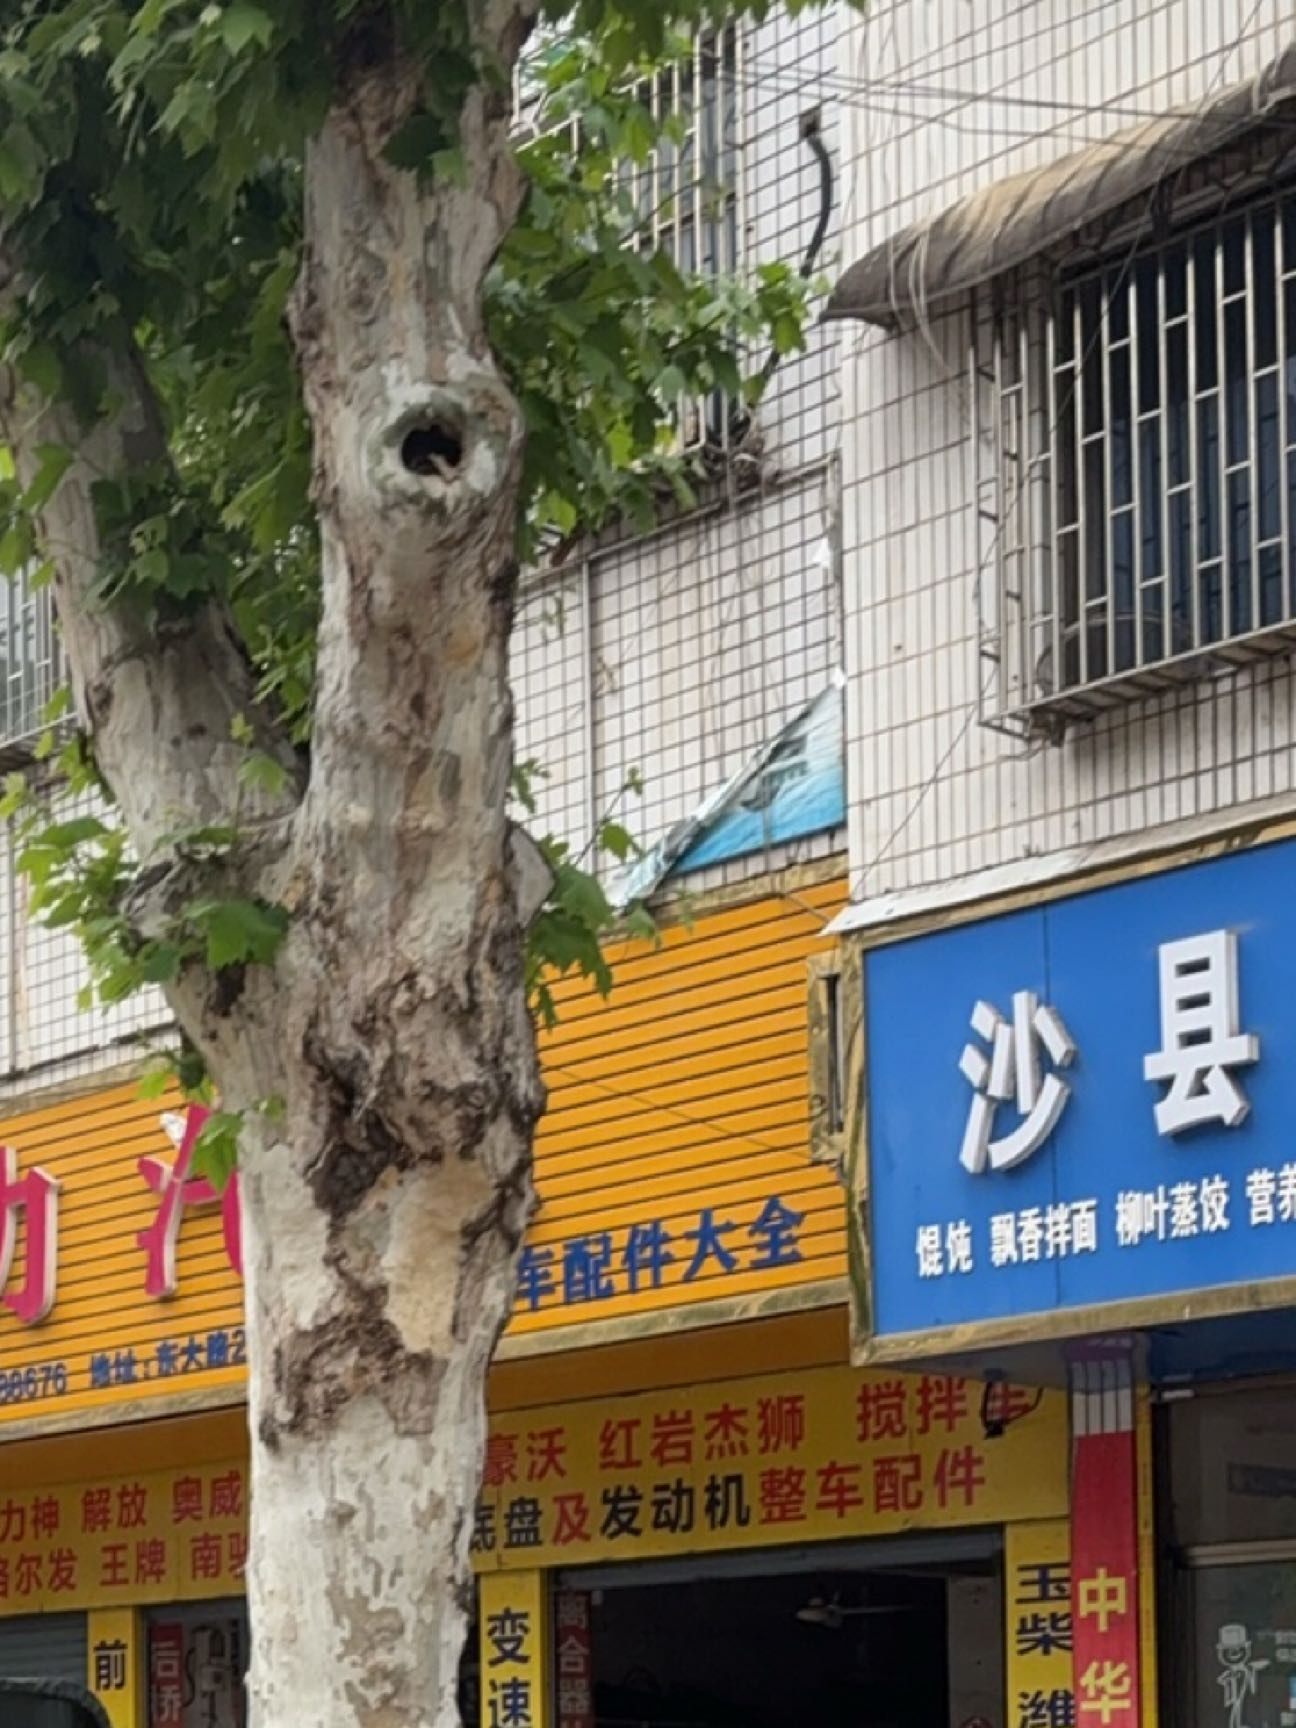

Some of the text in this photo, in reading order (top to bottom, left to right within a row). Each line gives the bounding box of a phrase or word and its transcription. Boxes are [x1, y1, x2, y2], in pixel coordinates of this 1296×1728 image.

[958, 928, 1261, 1175] 沙县
[990, 1198, 1098, 1268] 飘香拌面
[1115, 1173, 1231, 1247] 柳叶蒸饺
[599, 1395, 805, 1471] 红岩杰狮
[81, 1481, 148, 1535] 解放
[172, 1470, 243, 1526] 奥威
[100, 1534, 167, 1589] 王牌
[1016, 1562, 1073, 1656] 玉柴
